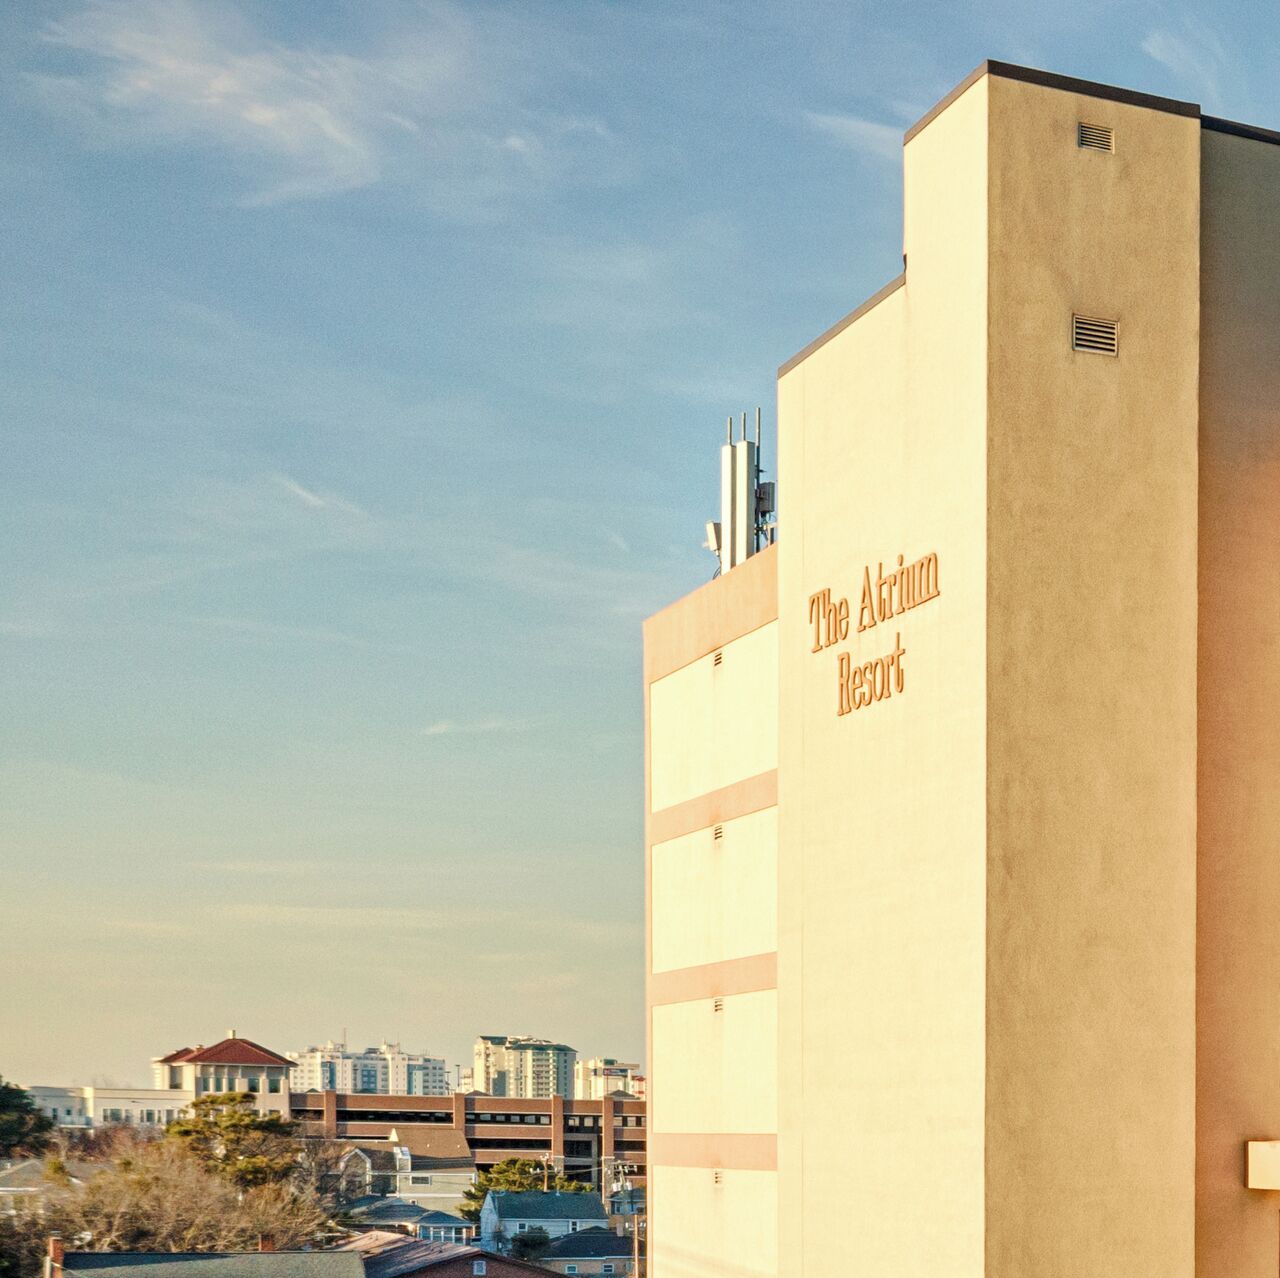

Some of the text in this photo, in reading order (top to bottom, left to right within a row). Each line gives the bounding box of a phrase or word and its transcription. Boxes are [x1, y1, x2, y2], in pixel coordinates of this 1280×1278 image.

[809, 552, 940, 653] The Atrium
[837, 632, 906, 716] Resort
